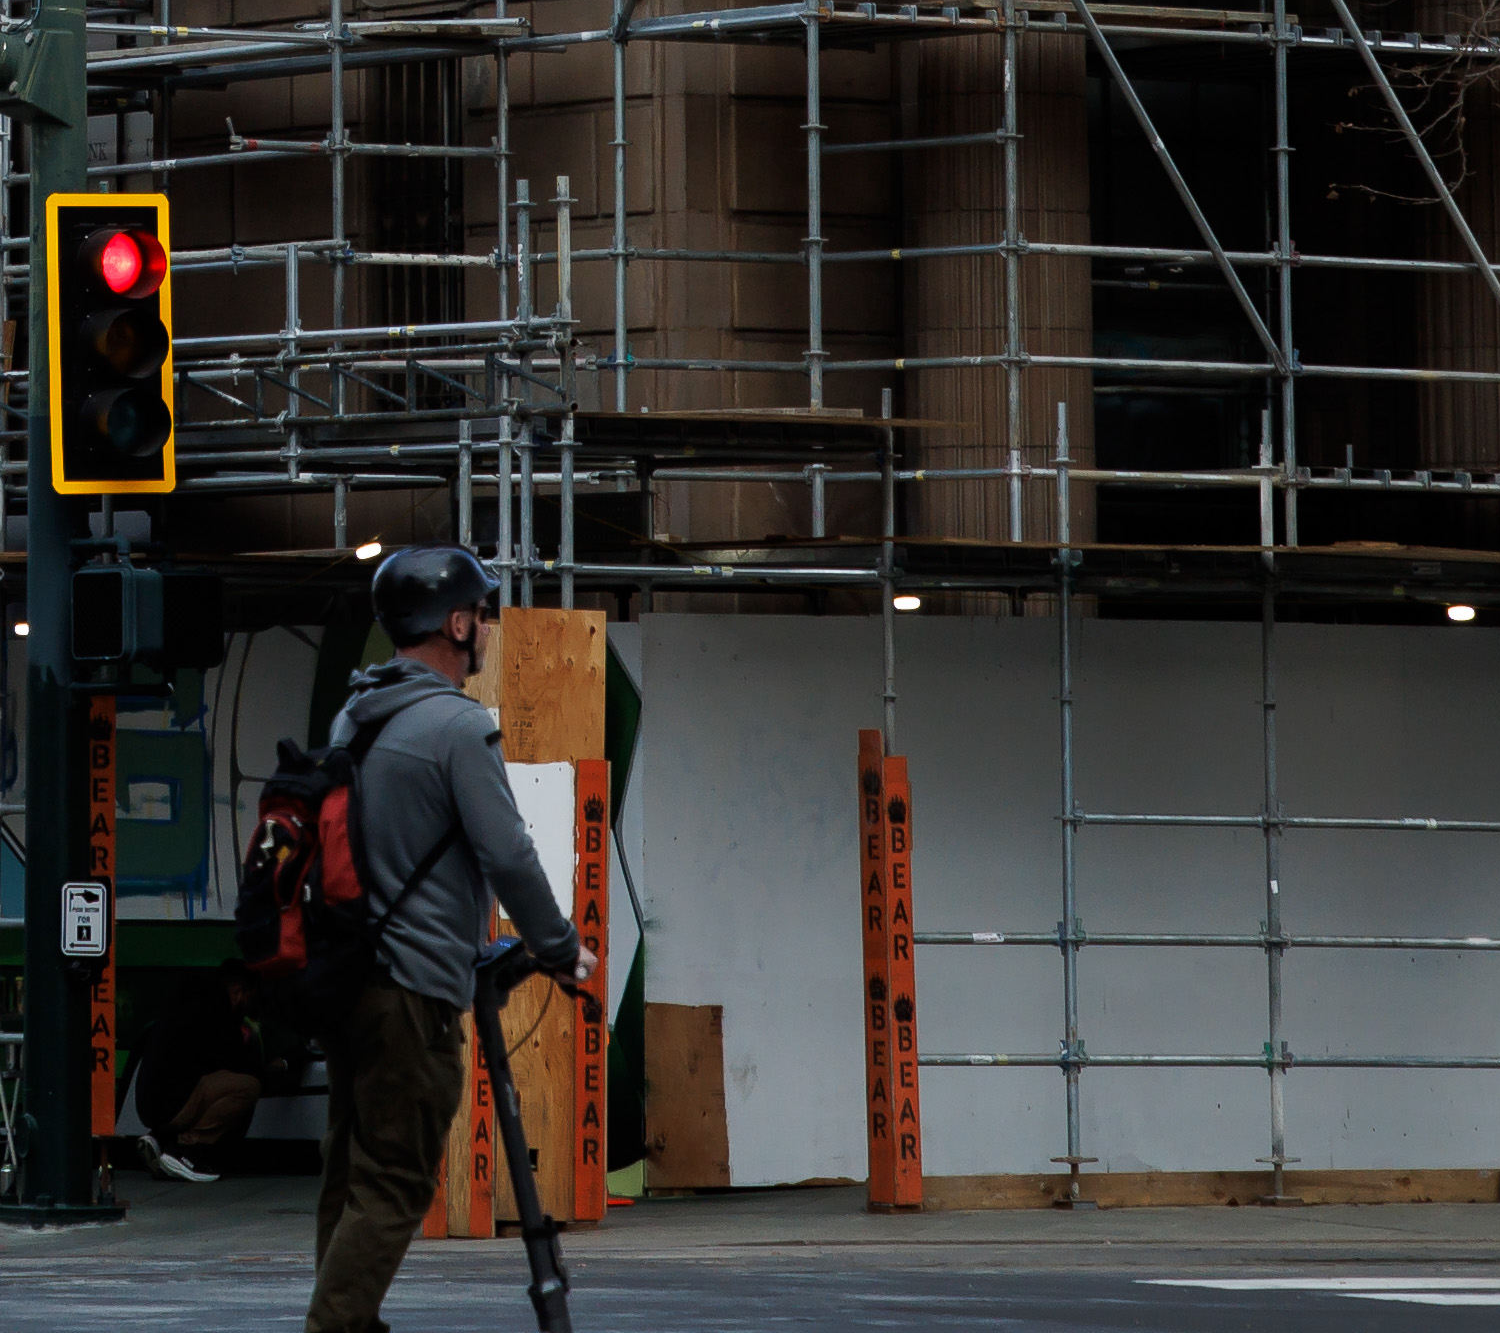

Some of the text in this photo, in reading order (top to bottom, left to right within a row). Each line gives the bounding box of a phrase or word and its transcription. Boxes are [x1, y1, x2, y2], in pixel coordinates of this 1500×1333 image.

[91, 744, 111, 872] BEAR
[865, 800, 883, 932] BEAR
[77, 915, 91, 924] FOR
[890, 826, 909, 962] BEAR
[91, 974, 111, 1074] EAR
[870, 1003, 888, 1140] BEAR
[473, 1044, 490, 1184] BEAR
[582, 1028, 601, 1167] BEAR
[896, 1024, 918, 1162] BEAR
